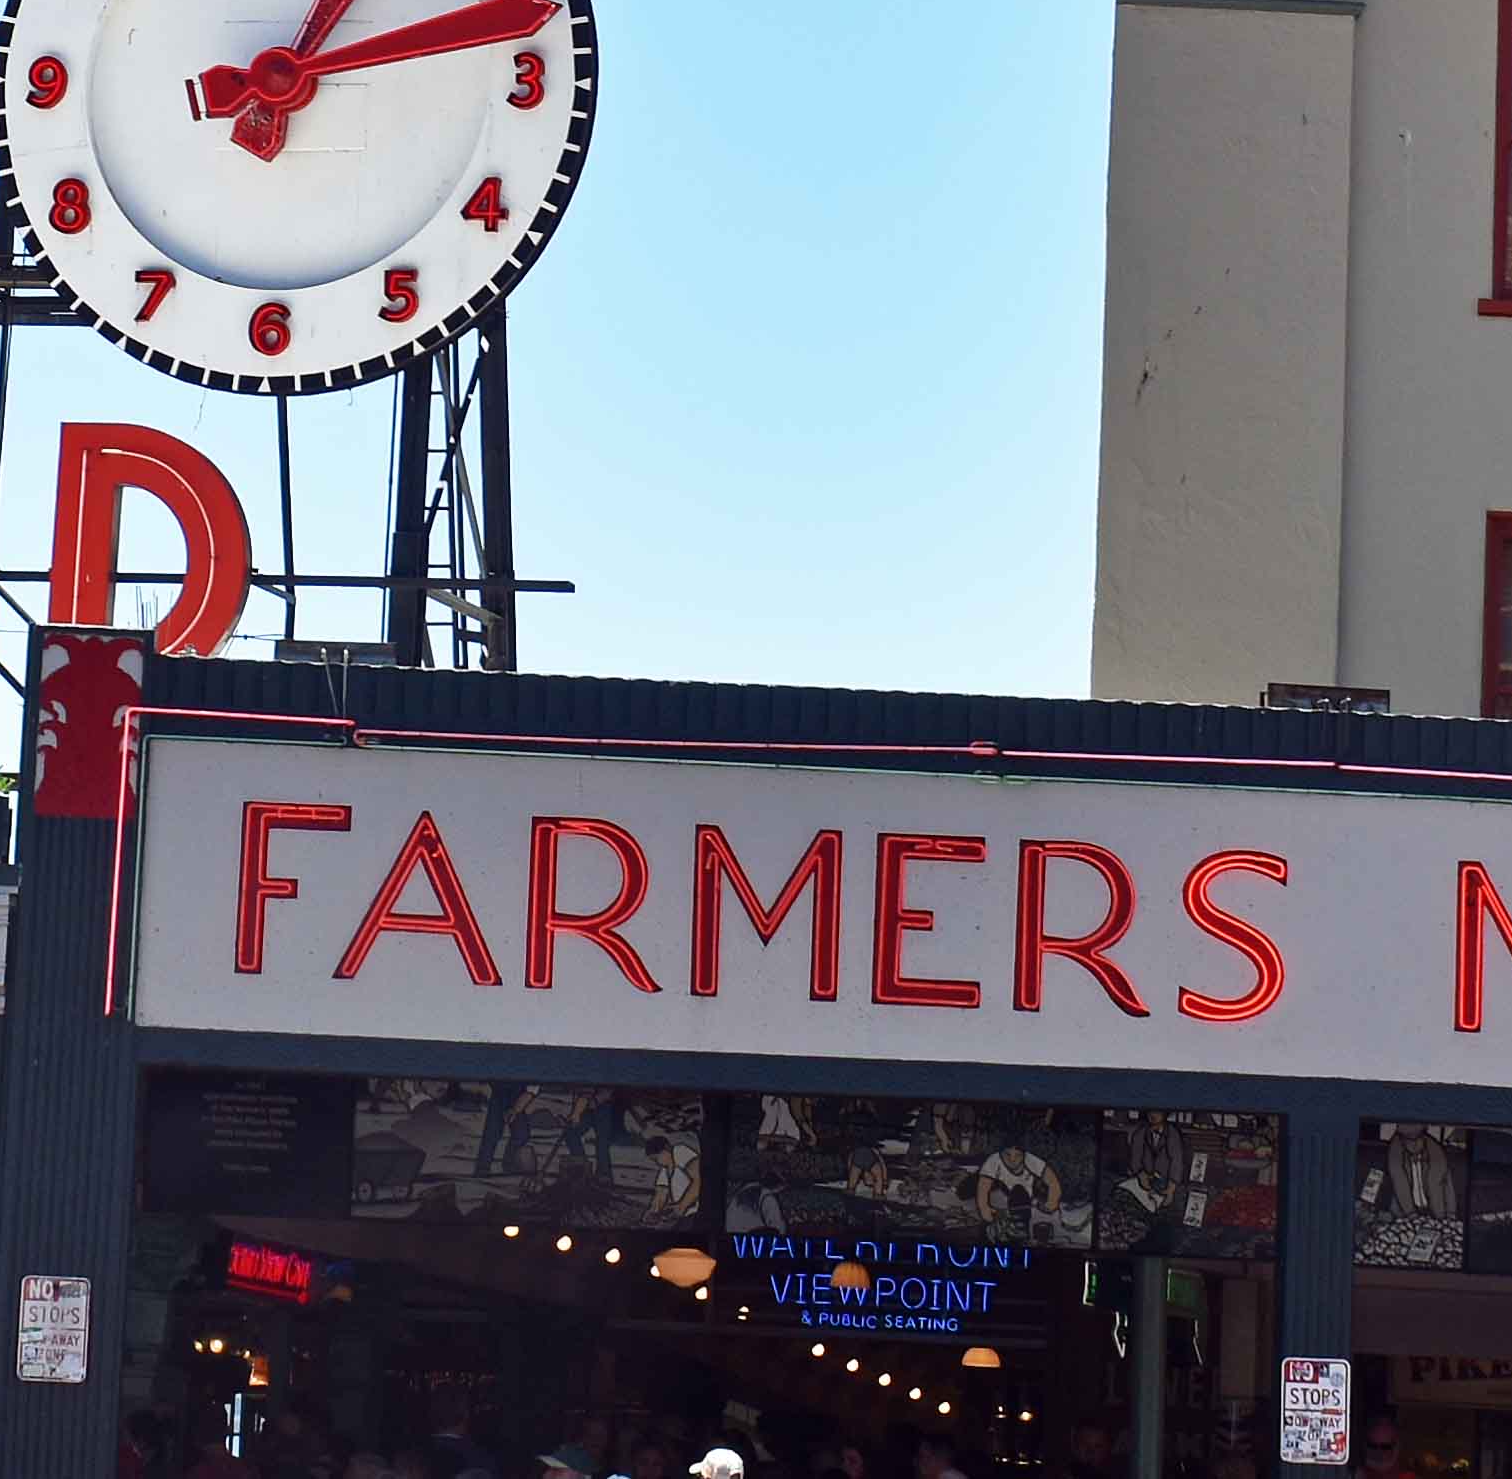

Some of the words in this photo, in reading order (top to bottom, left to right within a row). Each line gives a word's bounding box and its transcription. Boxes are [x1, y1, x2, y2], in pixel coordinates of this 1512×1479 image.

[27, 55, 68, 109] 9
[506, 53, 546, 109] 3
[49, 178, 90, 234] 8
[462, 178, 508, 232] 4
[135, 269, 176, 322] 7
[378, 269, 420, 322] 5
[248, 301, 290, 355] 6
[234, 800, 1288, 1022] FARMERS
[29, 1279, 54, 1300] NO
[29, 1305, 80, 1324] STOPS
[770, 1273, 998, 1312] VIEWPOINT
[801, 1311, 814, 1327] &
[819, 1313, 878, 1329] PUBLIC
[885, 1315, 959, 1332] SEATING
[1290, 1388, 1341, 1406] STOPS
